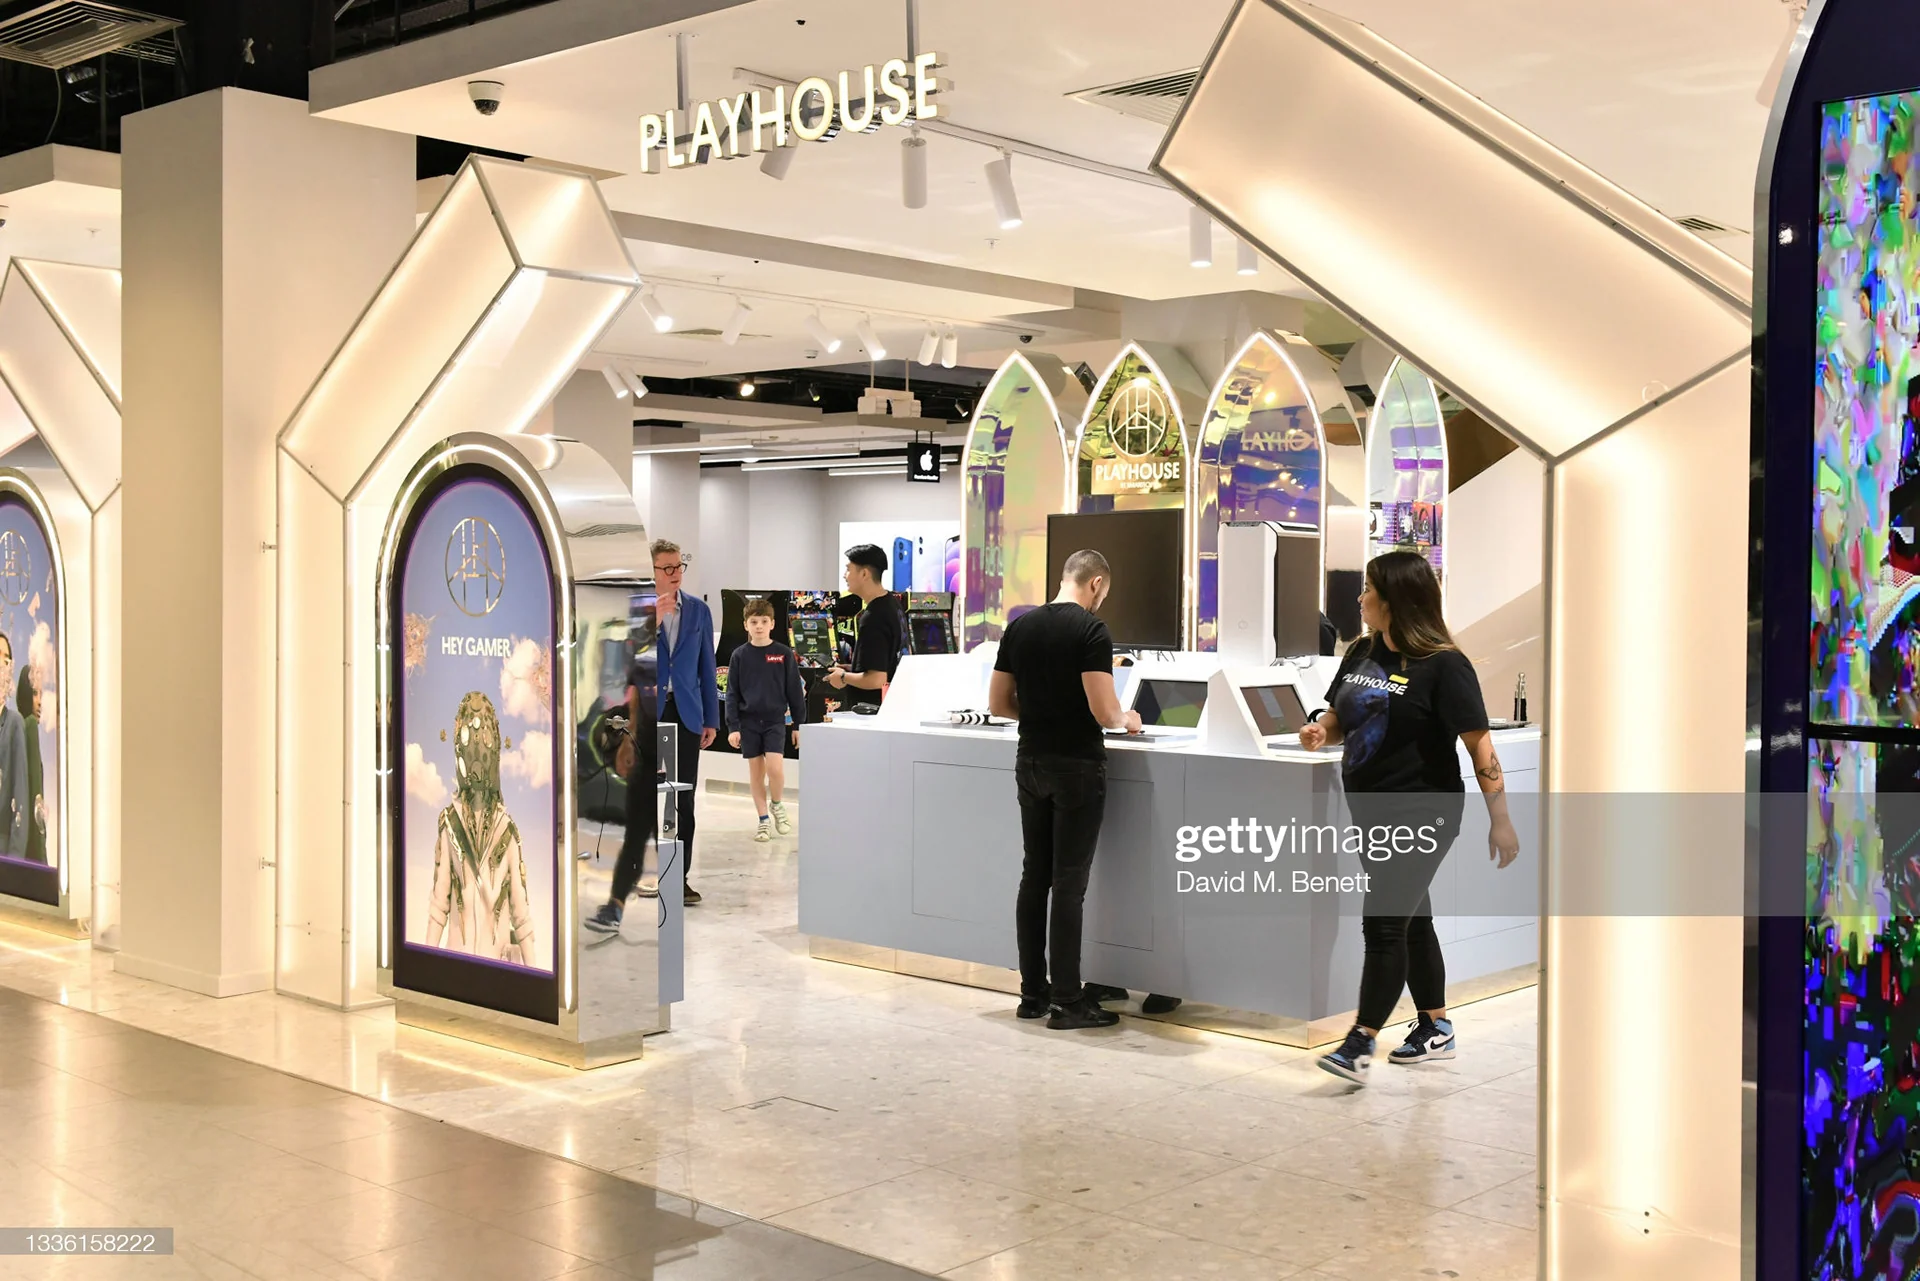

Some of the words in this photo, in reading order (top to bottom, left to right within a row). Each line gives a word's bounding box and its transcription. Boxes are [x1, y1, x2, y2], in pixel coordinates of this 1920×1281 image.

[639, 51, 938, 173] PLAYHOUSE
[1095, 461, 1180, 480] PLAYHOUSE
[441, 636, 464, 655] HEY
[465, 637, 511, 657] GAMER
[1342, 673, 1408, 696] PLAYHOUSE
